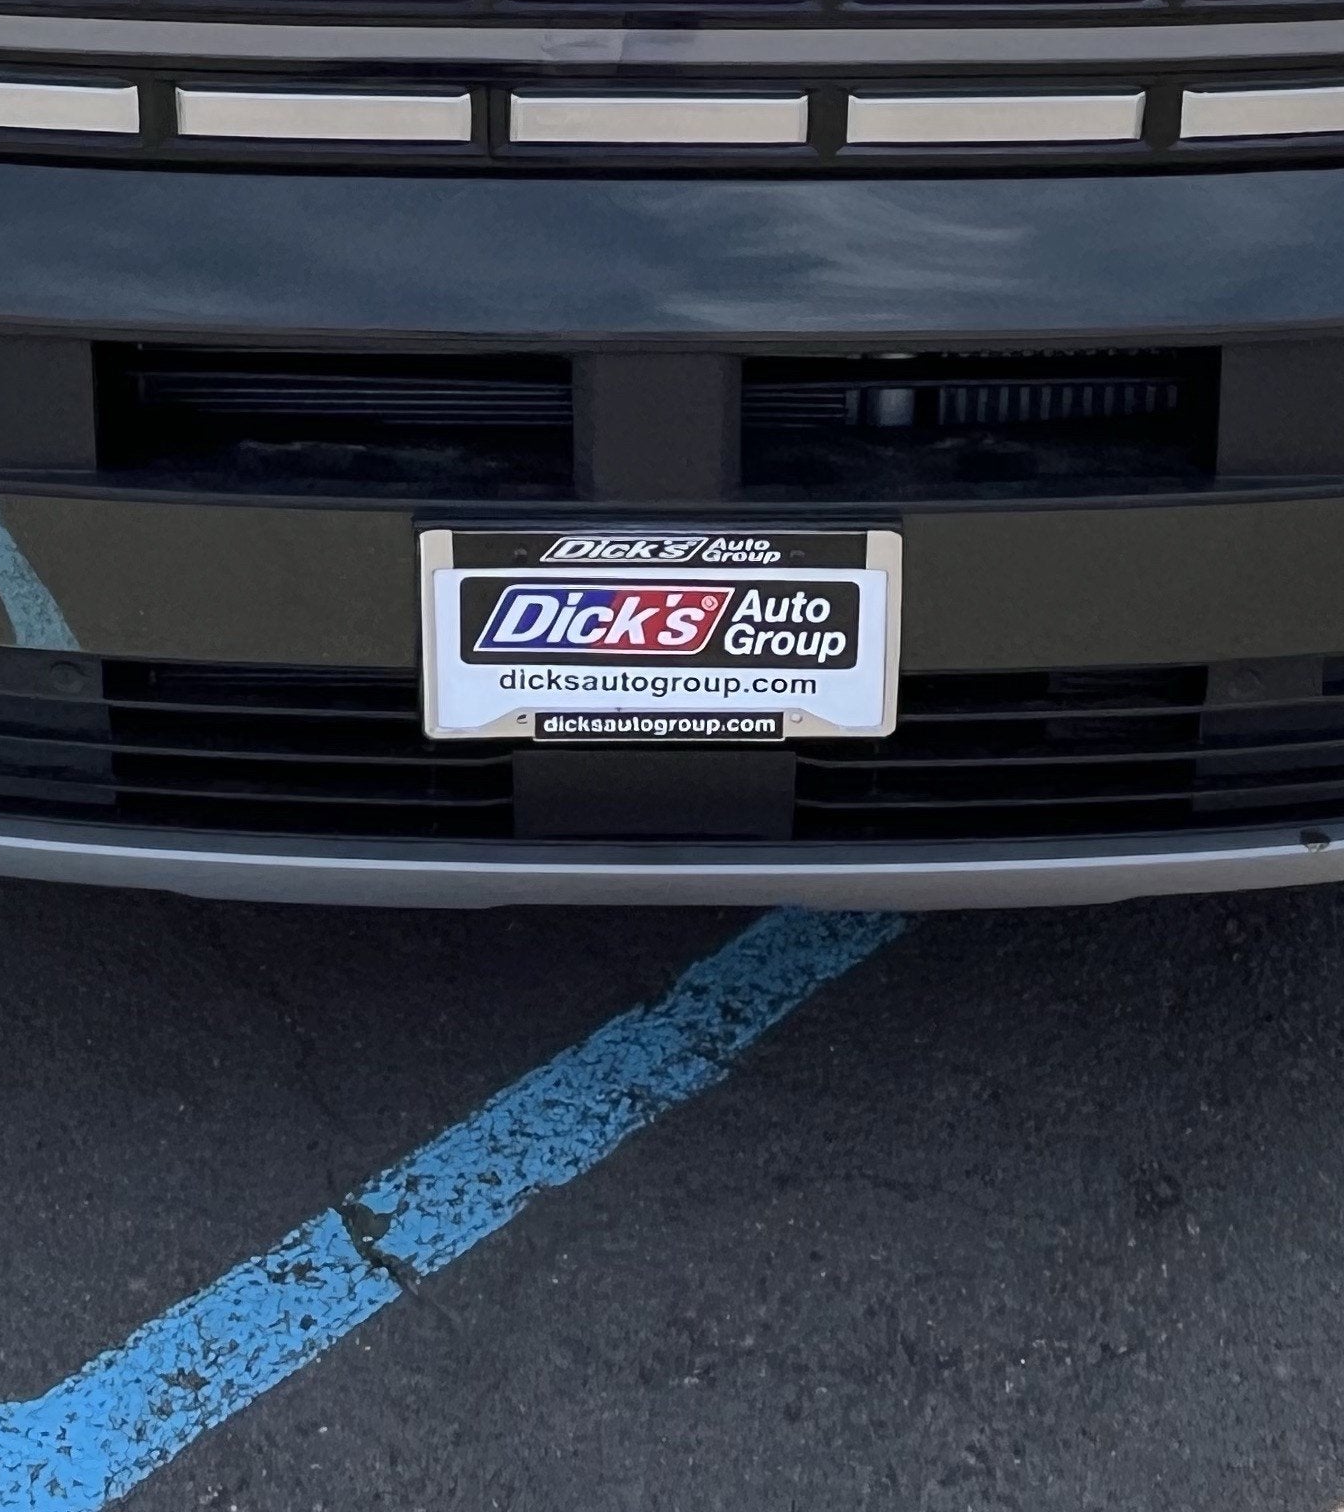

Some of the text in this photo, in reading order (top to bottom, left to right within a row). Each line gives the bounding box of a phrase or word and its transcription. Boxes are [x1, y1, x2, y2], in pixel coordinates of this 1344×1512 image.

[701, 549, 781, 564] Group
[707, 538, 771, 551] Auto
[492, 592, 703, 647] Dick's
[731, 589, 831, 624] Auto
[724, 622, 846, 663] Group
[499, 669, 817, 698] dicksautogroup.com
[544, 715, 776, 736] dicksautogroup.com
